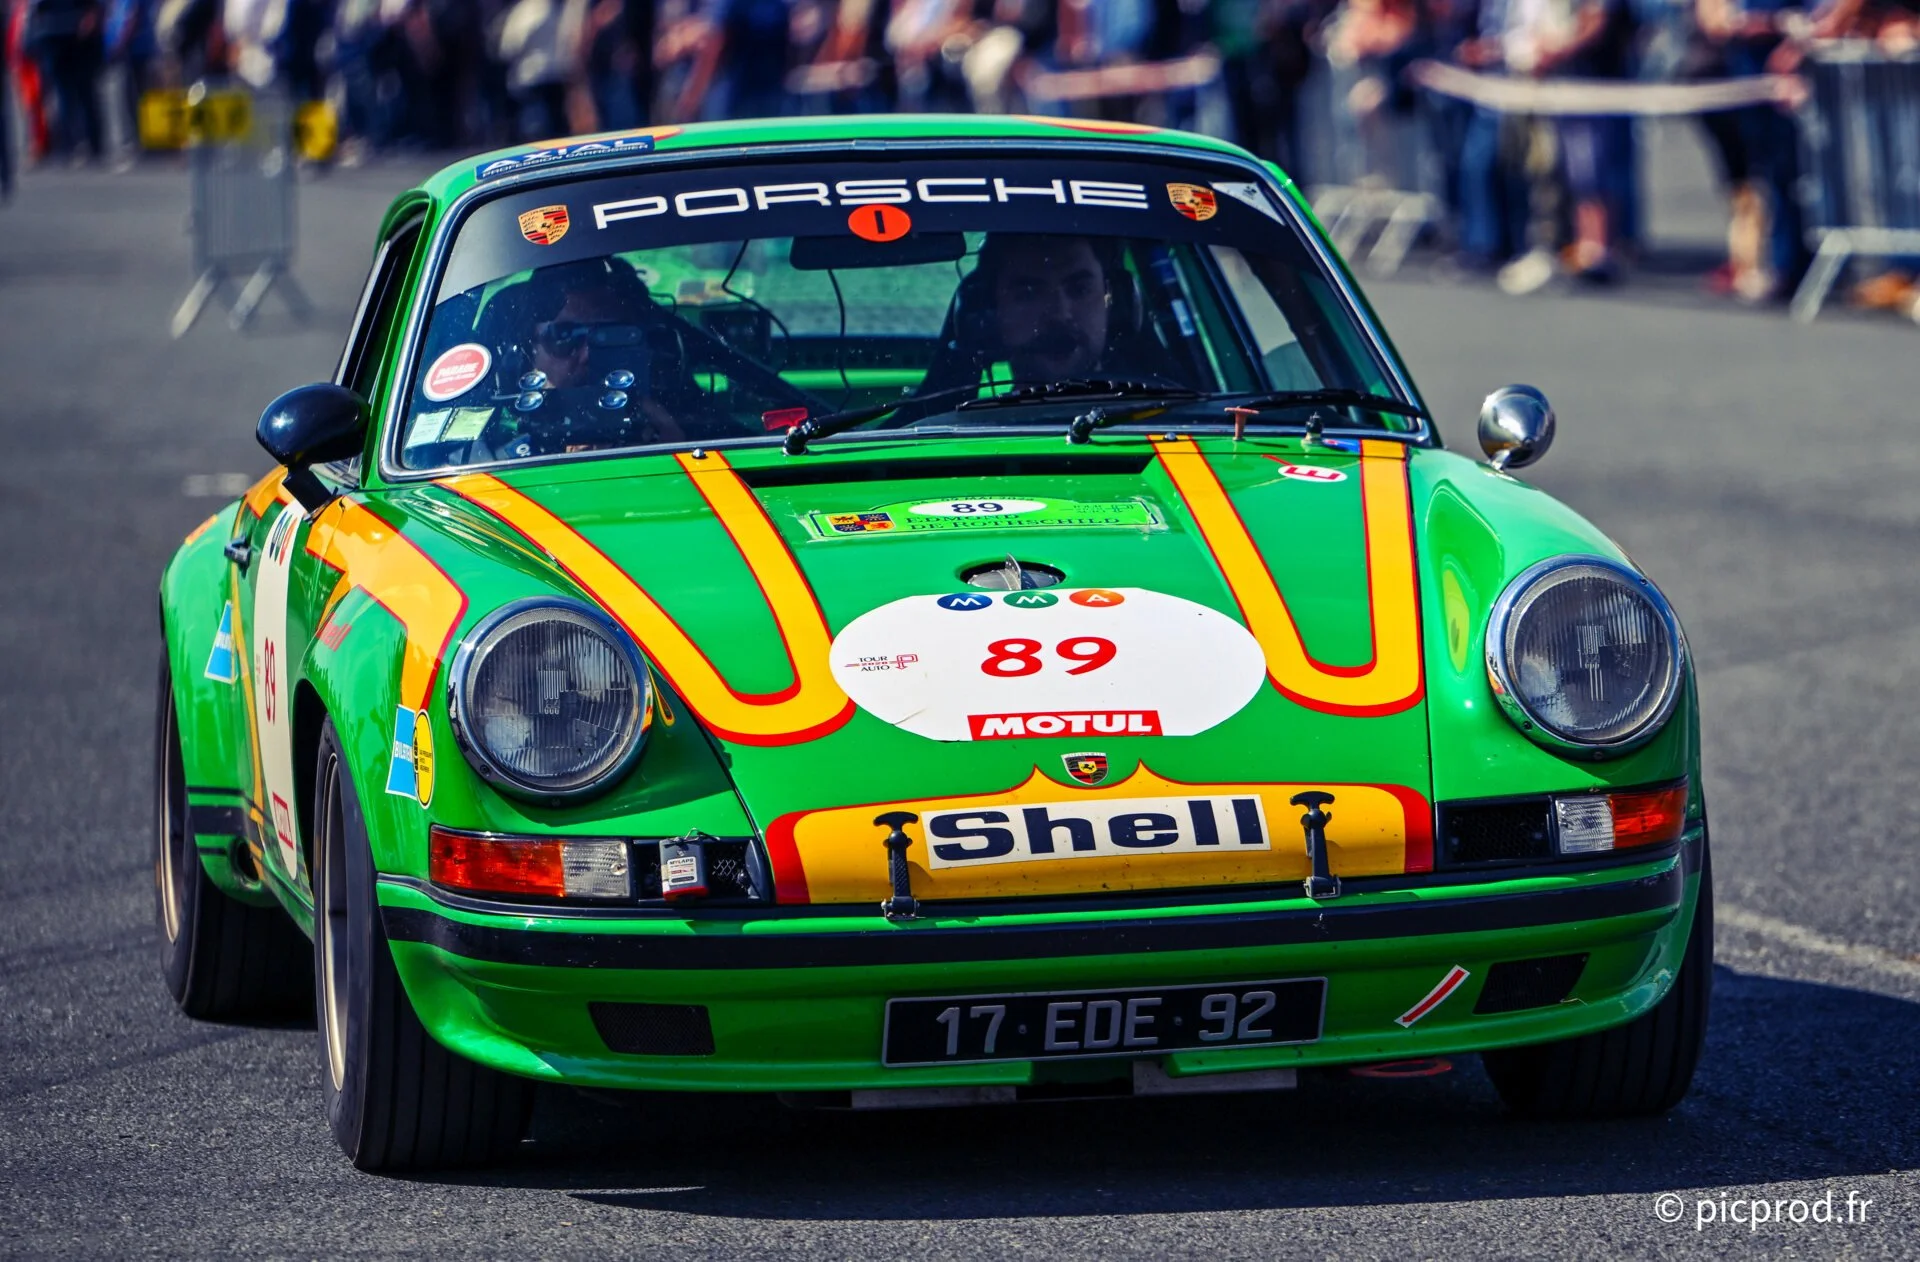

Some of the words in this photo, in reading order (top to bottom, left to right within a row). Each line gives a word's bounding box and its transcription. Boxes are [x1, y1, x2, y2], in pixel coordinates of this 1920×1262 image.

[481, 140, 647, 172] AXIAL
[592, 178, 1149, 229] PORSCHE
[906, 514, 1020, 523] EDMOND
[951, 502, 1004, 513] 89
[952, 518, 1120, 528] ROTHSCHILD
[981, 636, 1117, 677] 89
[264, 636, 276, 727] 89
[980, 713, 1153, 738] MOTUL
[929, 798, 1265, 861] Shell
[935, 1004, 1007, 1056] 17
[1044, 997, 1163, 1051] EDE
[1198, 990, 1277, 1041] 92
